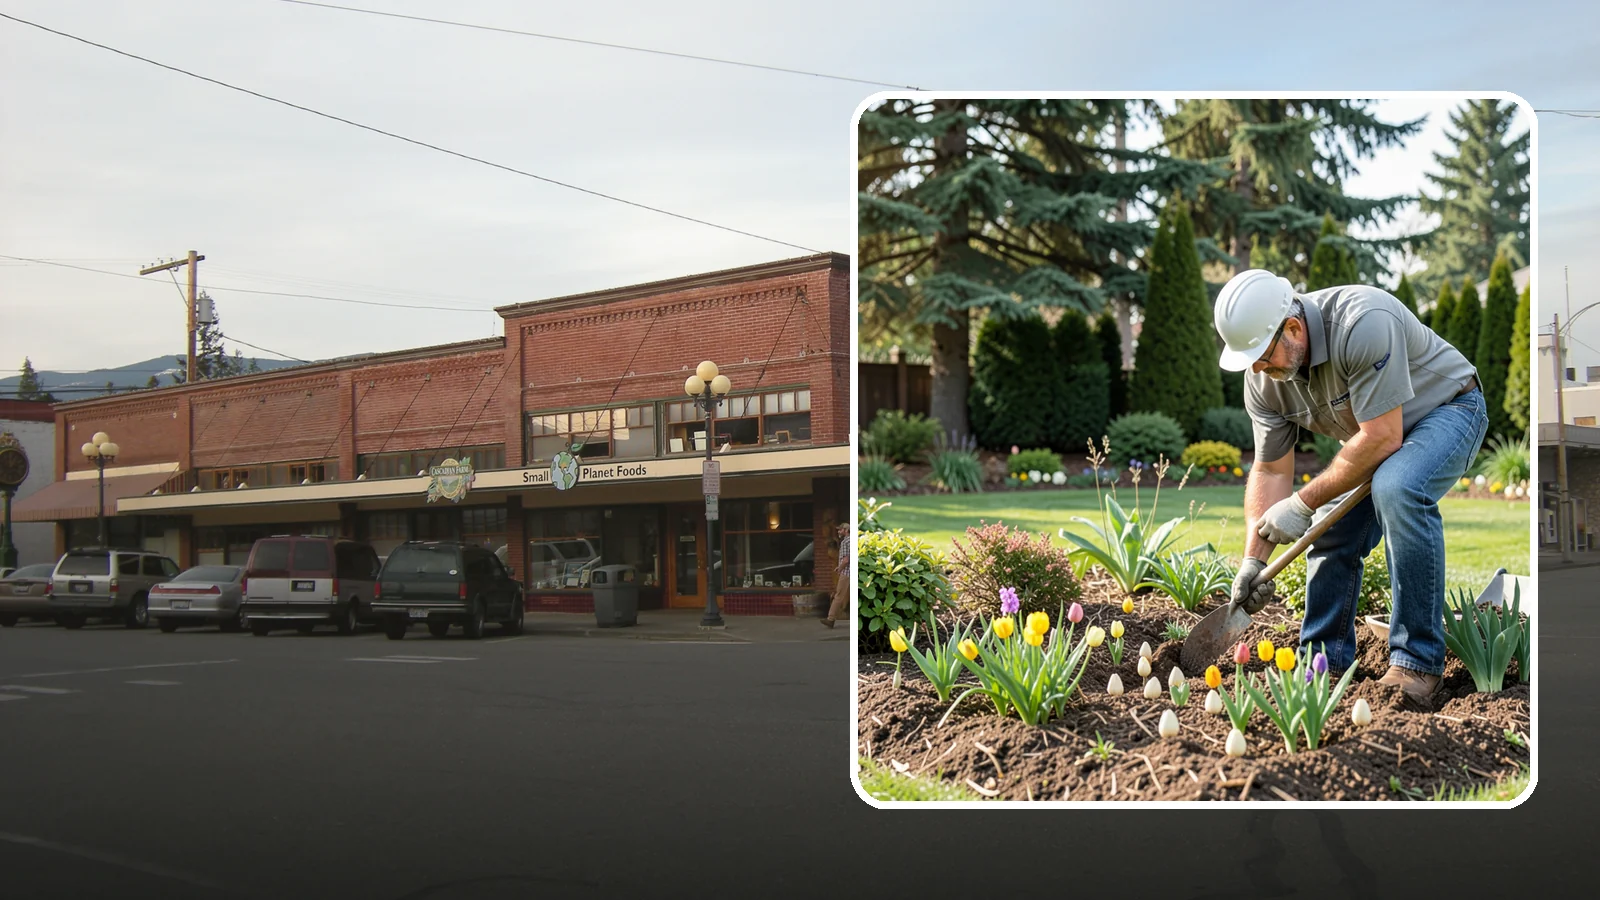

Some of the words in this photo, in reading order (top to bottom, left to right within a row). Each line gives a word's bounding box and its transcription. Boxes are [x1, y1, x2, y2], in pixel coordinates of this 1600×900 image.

[523, 471, 549, 483] Small
[583, 468, 614, 479] Planet
[617, 464, 647, 477] Foods
